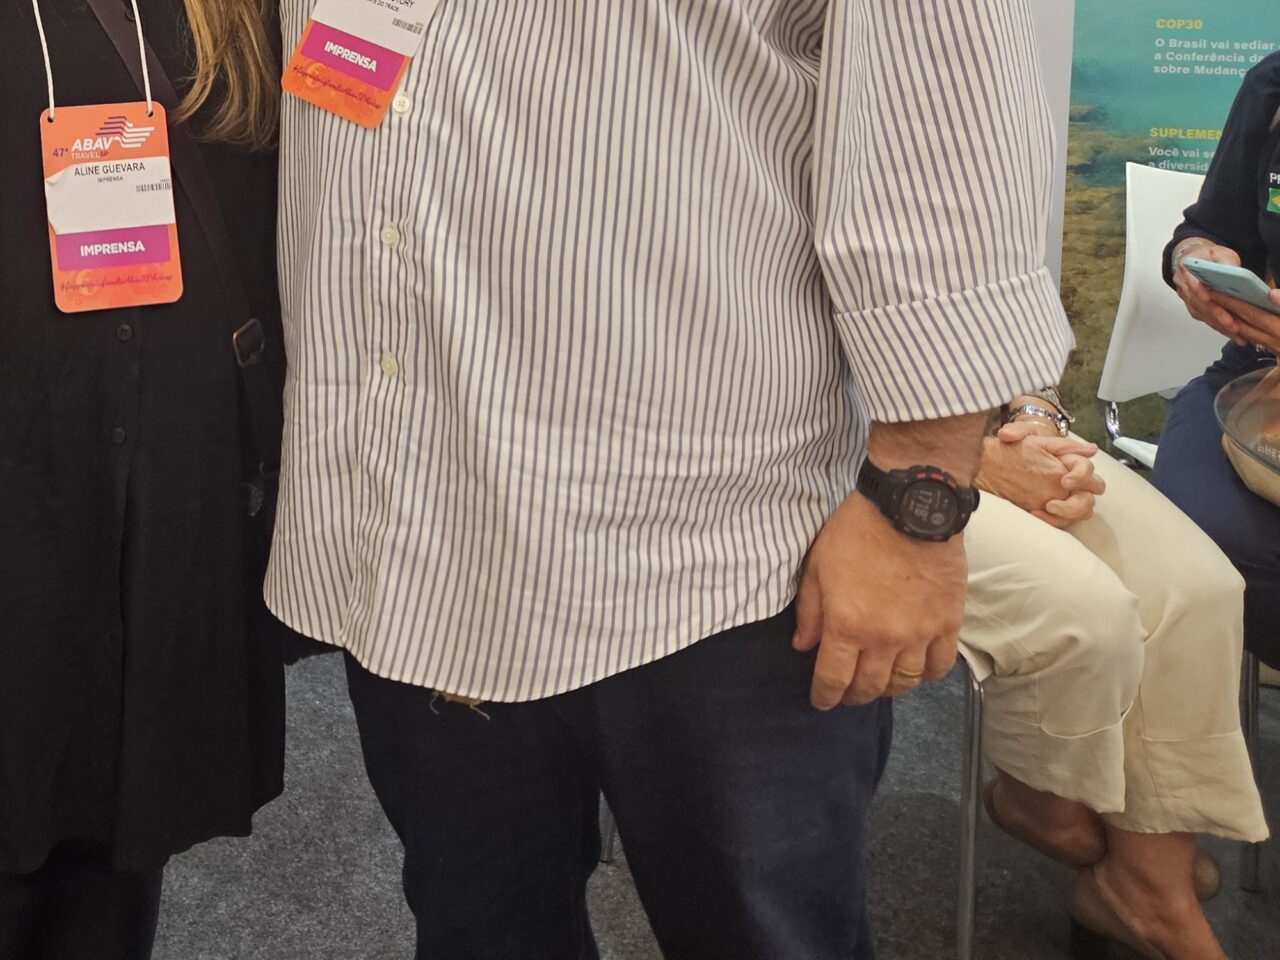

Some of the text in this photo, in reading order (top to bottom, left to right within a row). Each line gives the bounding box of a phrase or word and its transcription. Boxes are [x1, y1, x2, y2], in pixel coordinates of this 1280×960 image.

[1155, 19, 1203, 29] COP30
[1155, 38, 1274, 50] O Brasil vai sediar
[324, 41, 378, 72] IMPRENSA
[1166, 52, 1245, 62] Conferência
[1153, 64, 1247, 78] sobre Mudanç
[1150, 127, 1222, 139] SUPLEMEN
[71, 137, 113, 152] ABAV
[1148, 147, 1179, 157] Você
[1182, 149, 1200, 158] vai
[74, 162, 145, 176] ALINE GUEVARA
[1158, 160, 1209, 171] diversid
[80, 240, 145, 257] IMPRENSA
